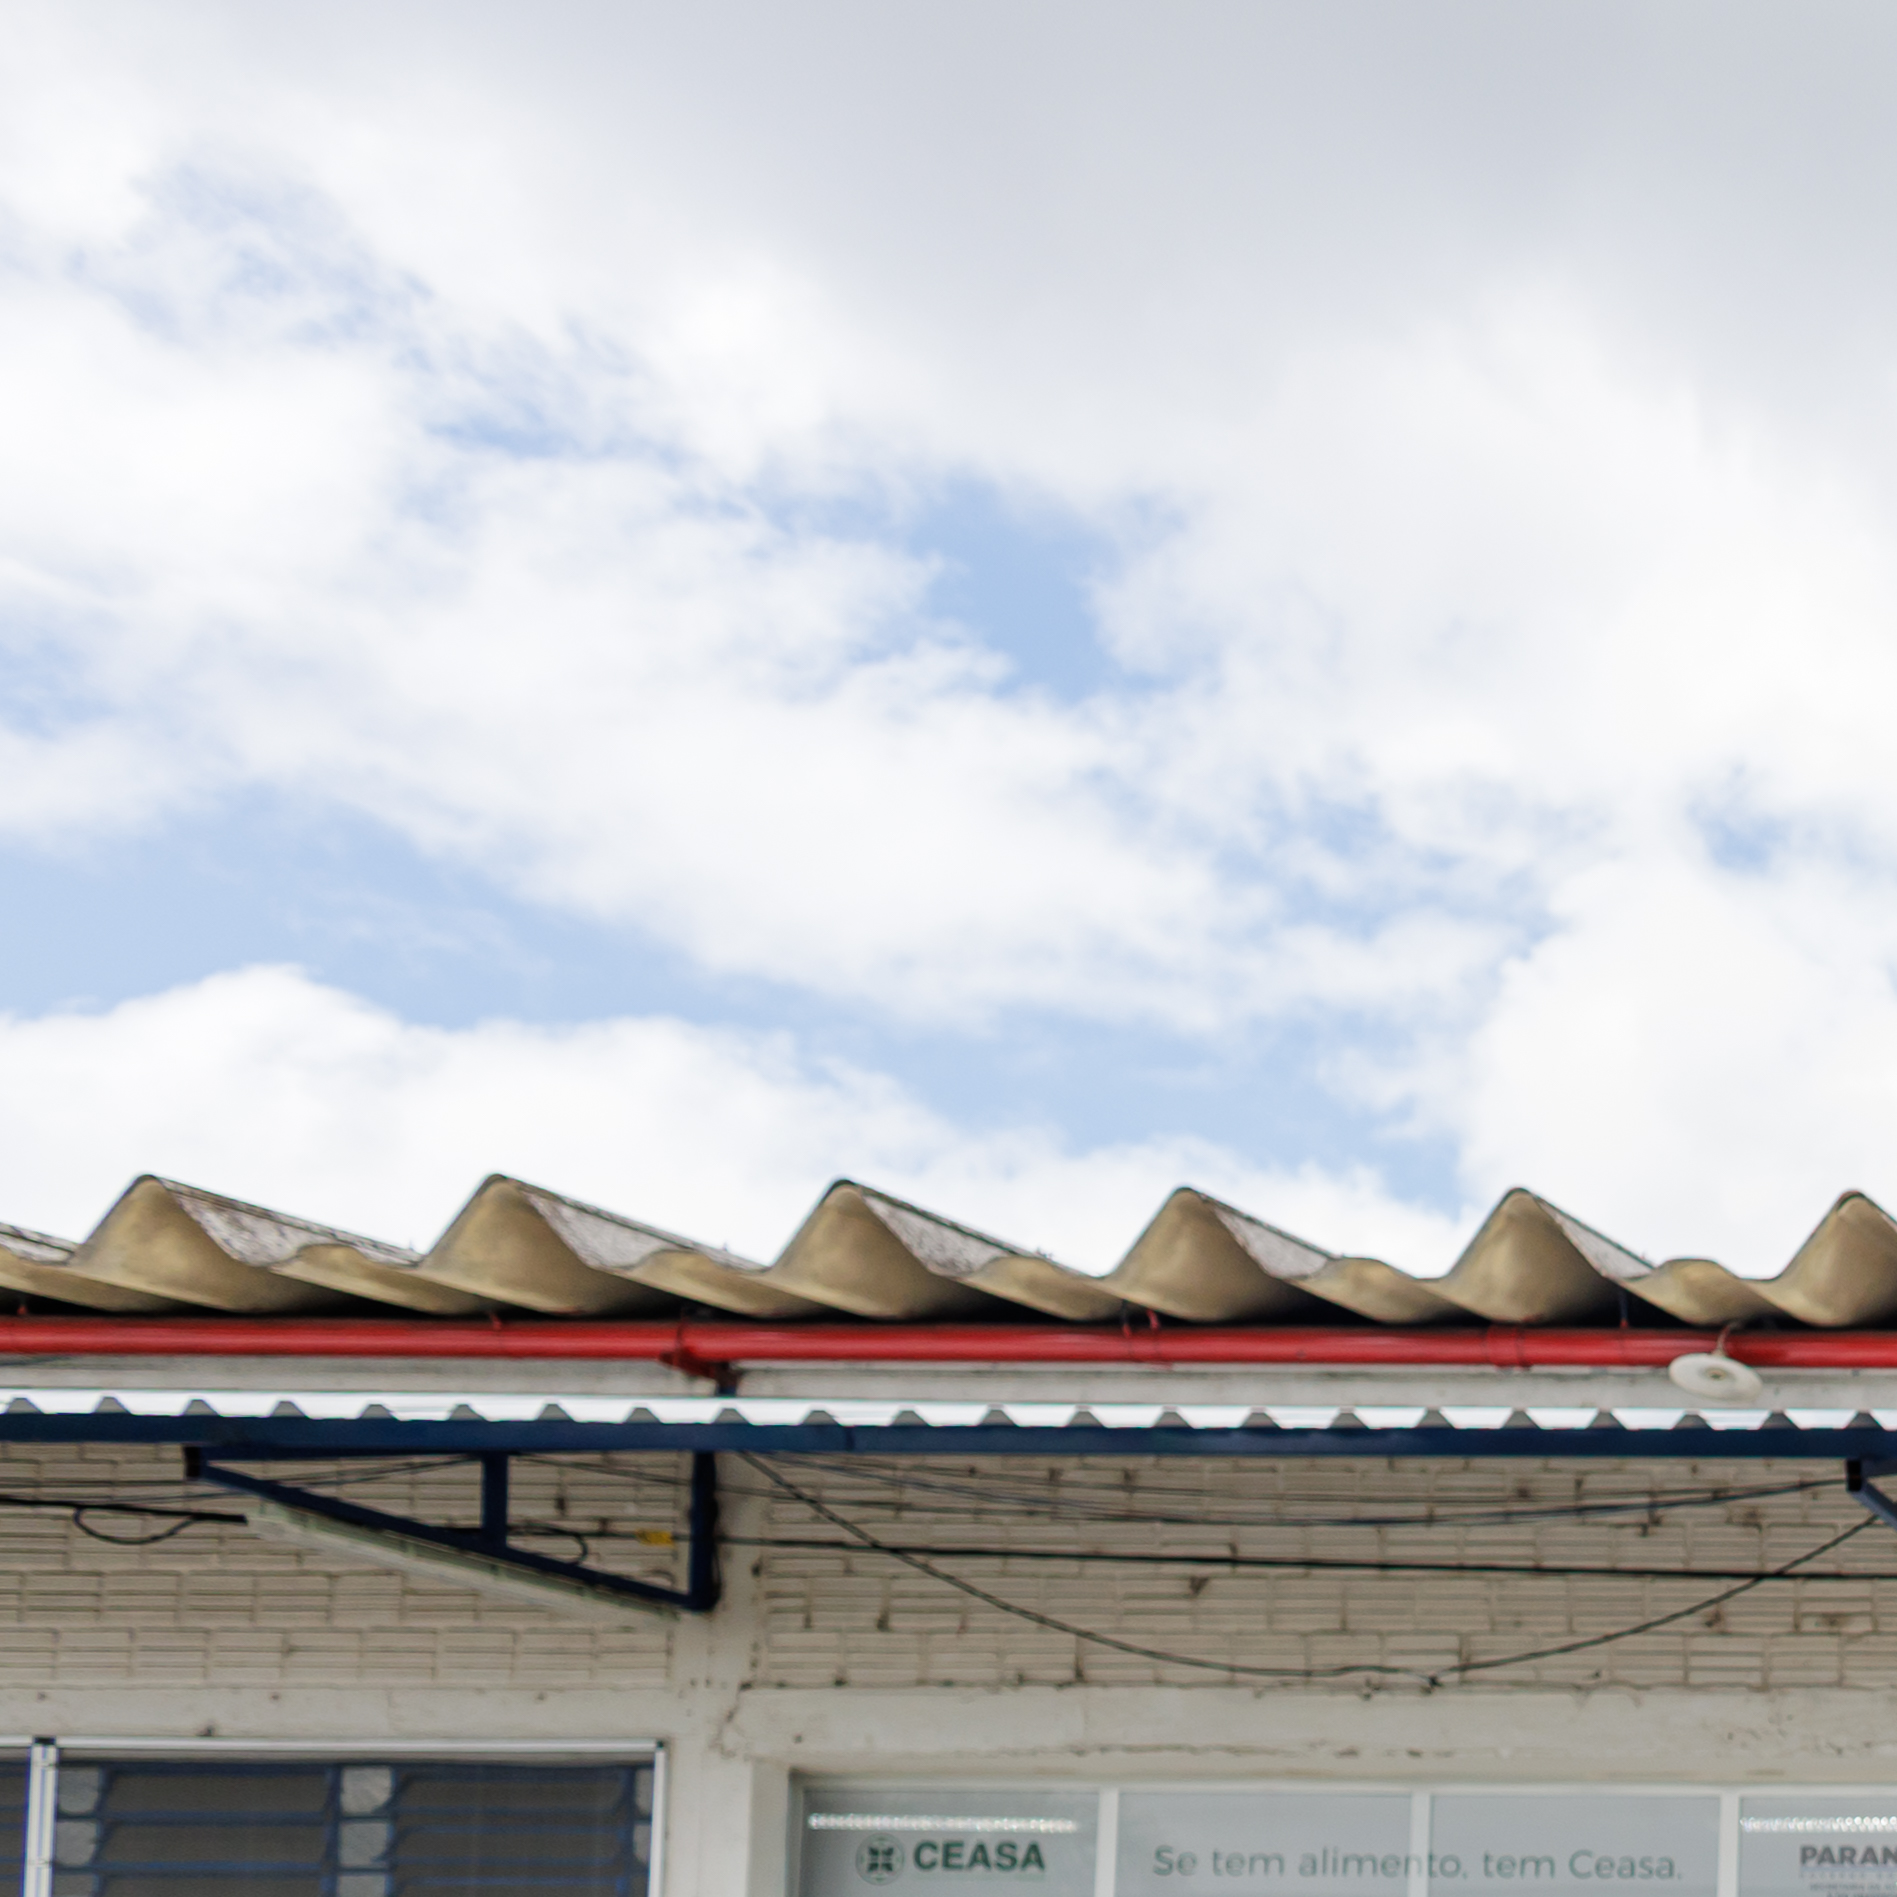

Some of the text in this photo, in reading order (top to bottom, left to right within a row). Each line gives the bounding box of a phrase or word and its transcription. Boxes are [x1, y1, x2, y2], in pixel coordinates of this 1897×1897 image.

[913, 1840, 1046, 1871] CEASA
[1152, 1844, 1683, 1880] Se tem alimento, tem Ceasa.
